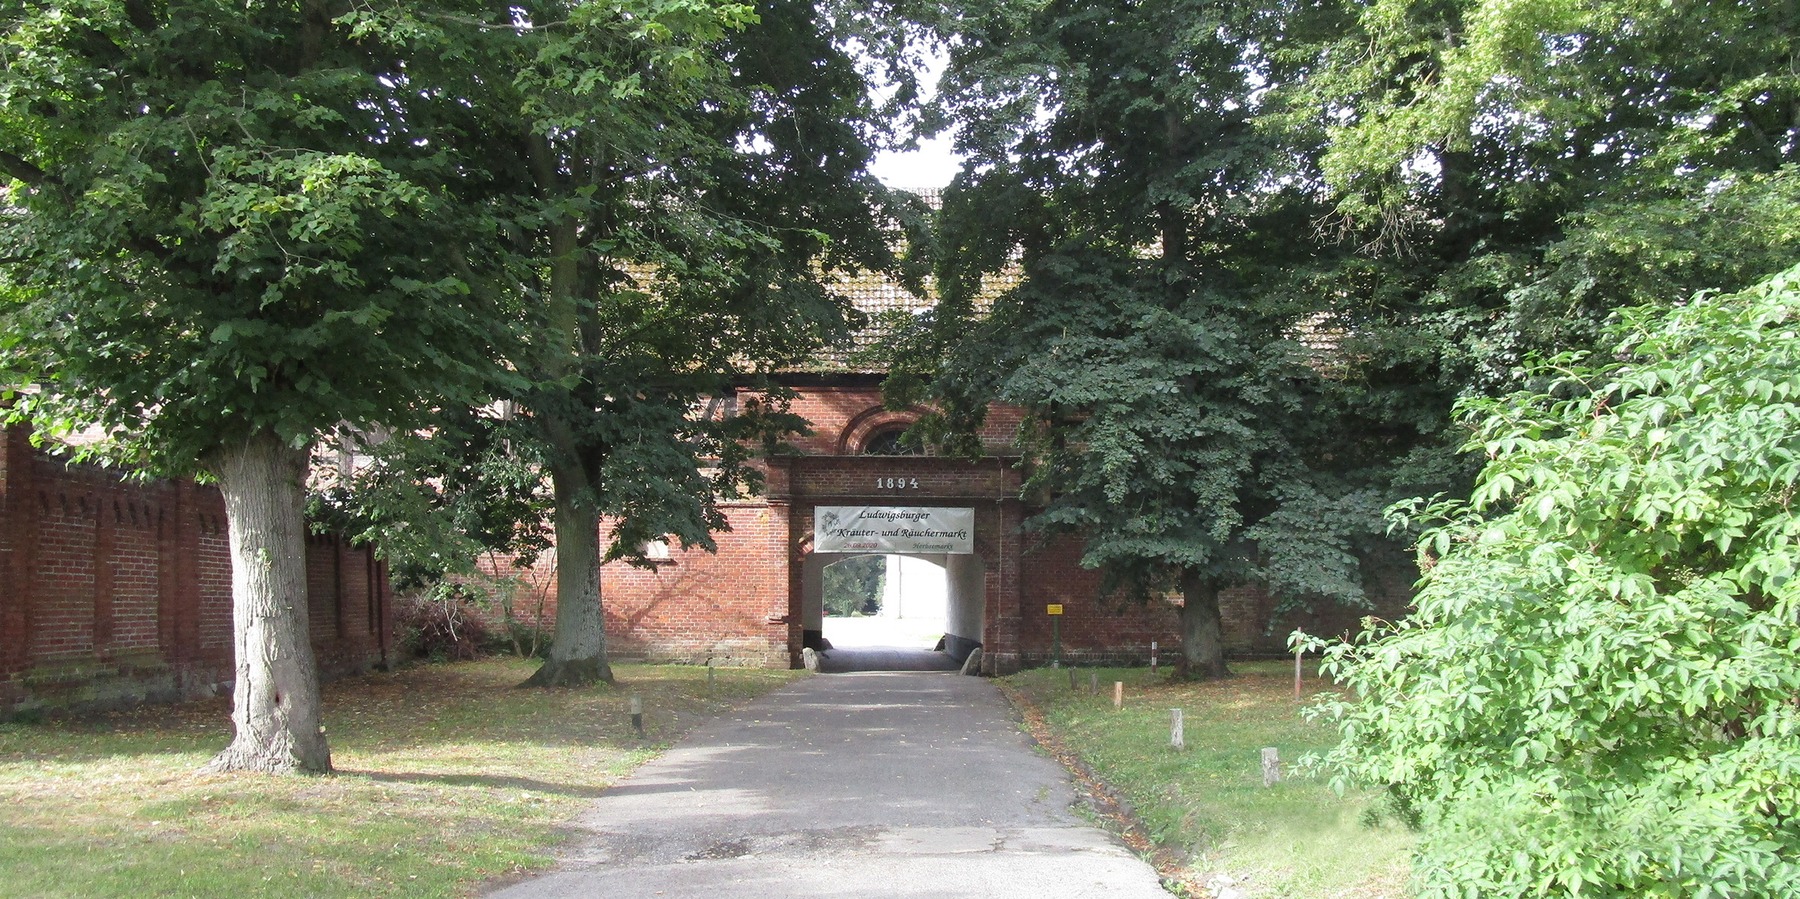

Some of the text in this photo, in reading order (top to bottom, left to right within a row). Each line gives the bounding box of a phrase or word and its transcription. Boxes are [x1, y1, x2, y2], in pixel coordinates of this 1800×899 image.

[877, 478, 918, 489] 1894
[859, 510, 930, 522] Ludwigsburger
[837, 527, 967, 540] Kräuter- und Räuchermarkt
